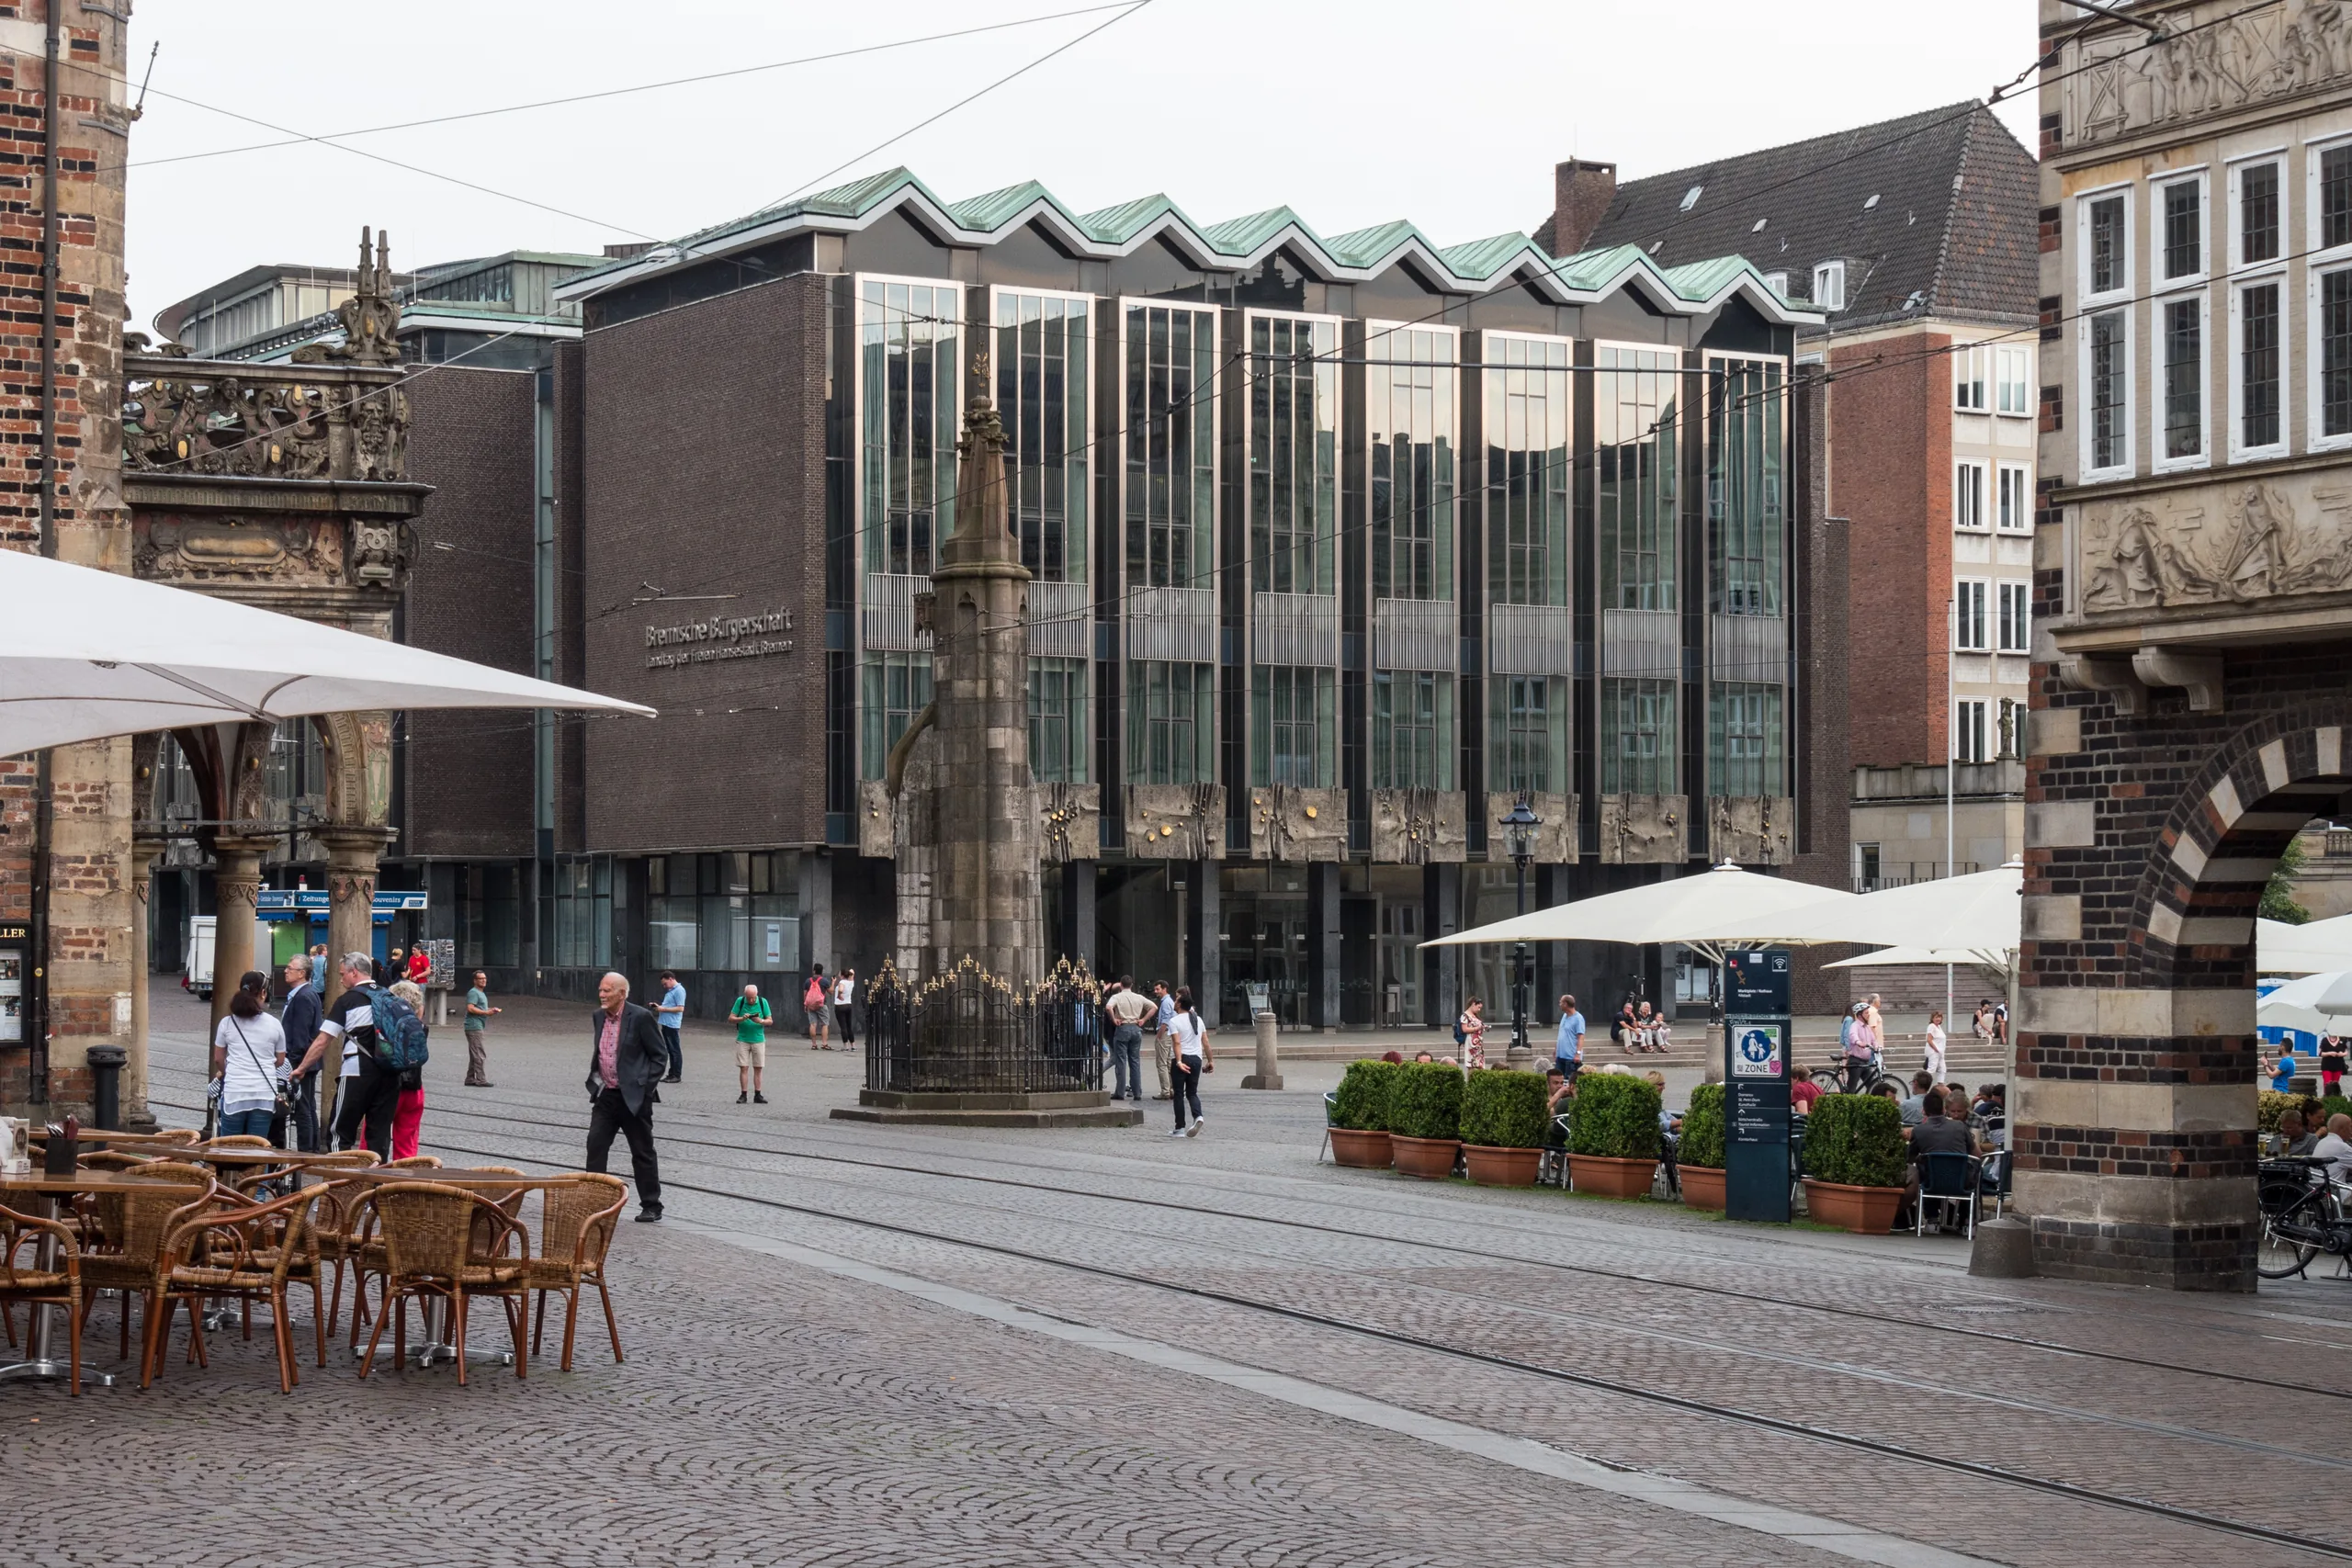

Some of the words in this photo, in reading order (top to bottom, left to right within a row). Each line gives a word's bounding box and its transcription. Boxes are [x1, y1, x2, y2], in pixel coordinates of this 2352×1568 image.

[646, 618, 707, 647] Bremische
[709, 606, 793, 642] Bürgerschaft
[676, 649, 689, 663] der
[691, 648, 716, 662] Freien
[0, 928, 26, 938] LER
[1745, 1064, 1769, 1073] ZONE
